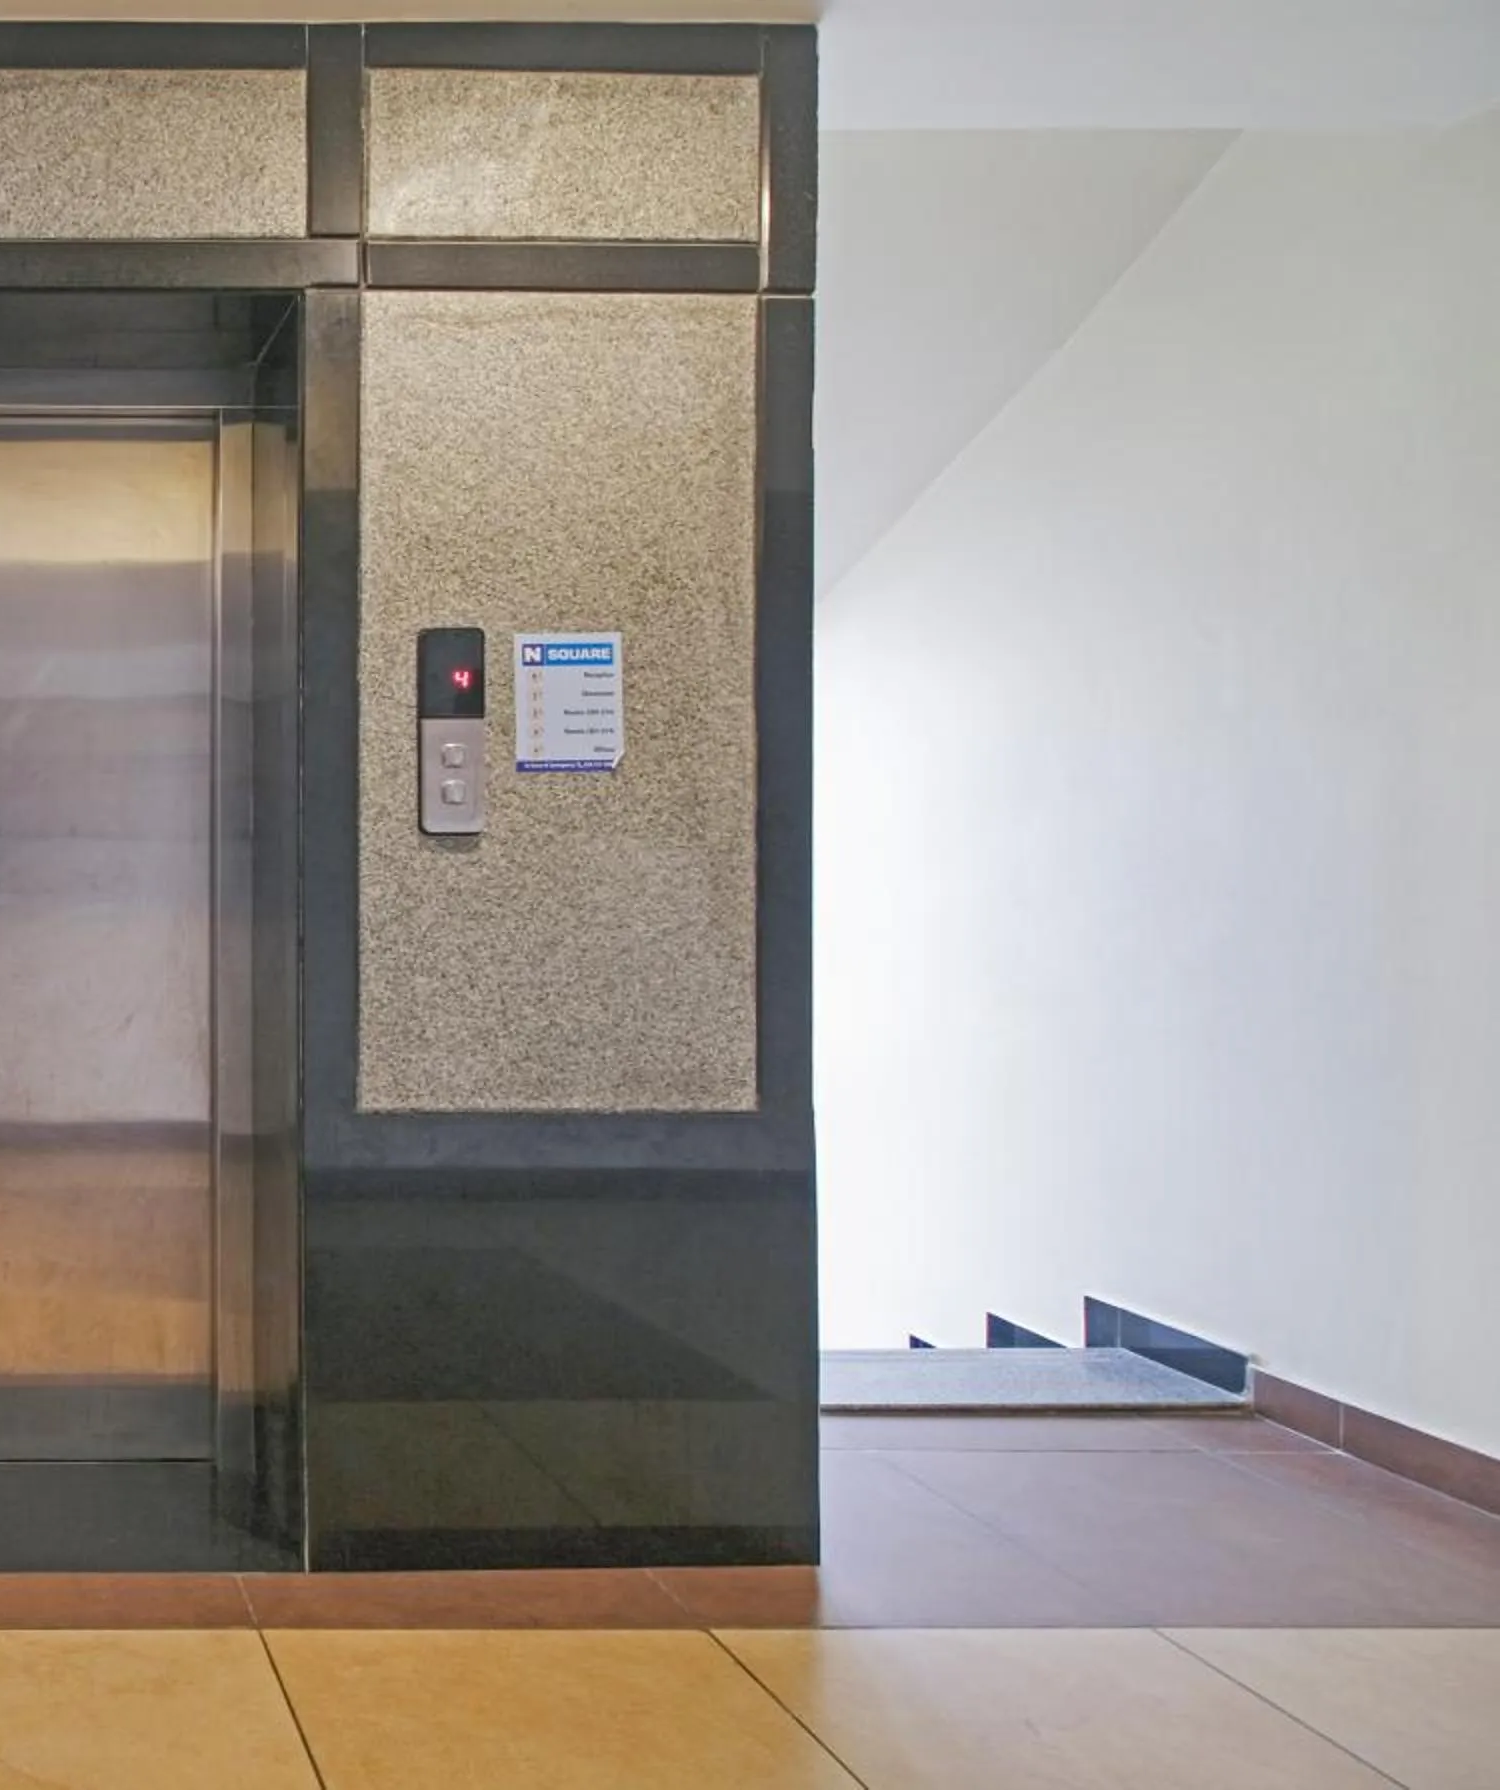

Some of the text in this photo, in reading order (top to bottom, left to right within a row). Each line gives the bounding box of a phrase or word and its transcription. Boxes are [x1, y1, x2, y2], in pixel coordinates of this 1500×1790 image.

[523, 646, 612, 663] N SQUARE
[453, 670, 470, 689] 4
